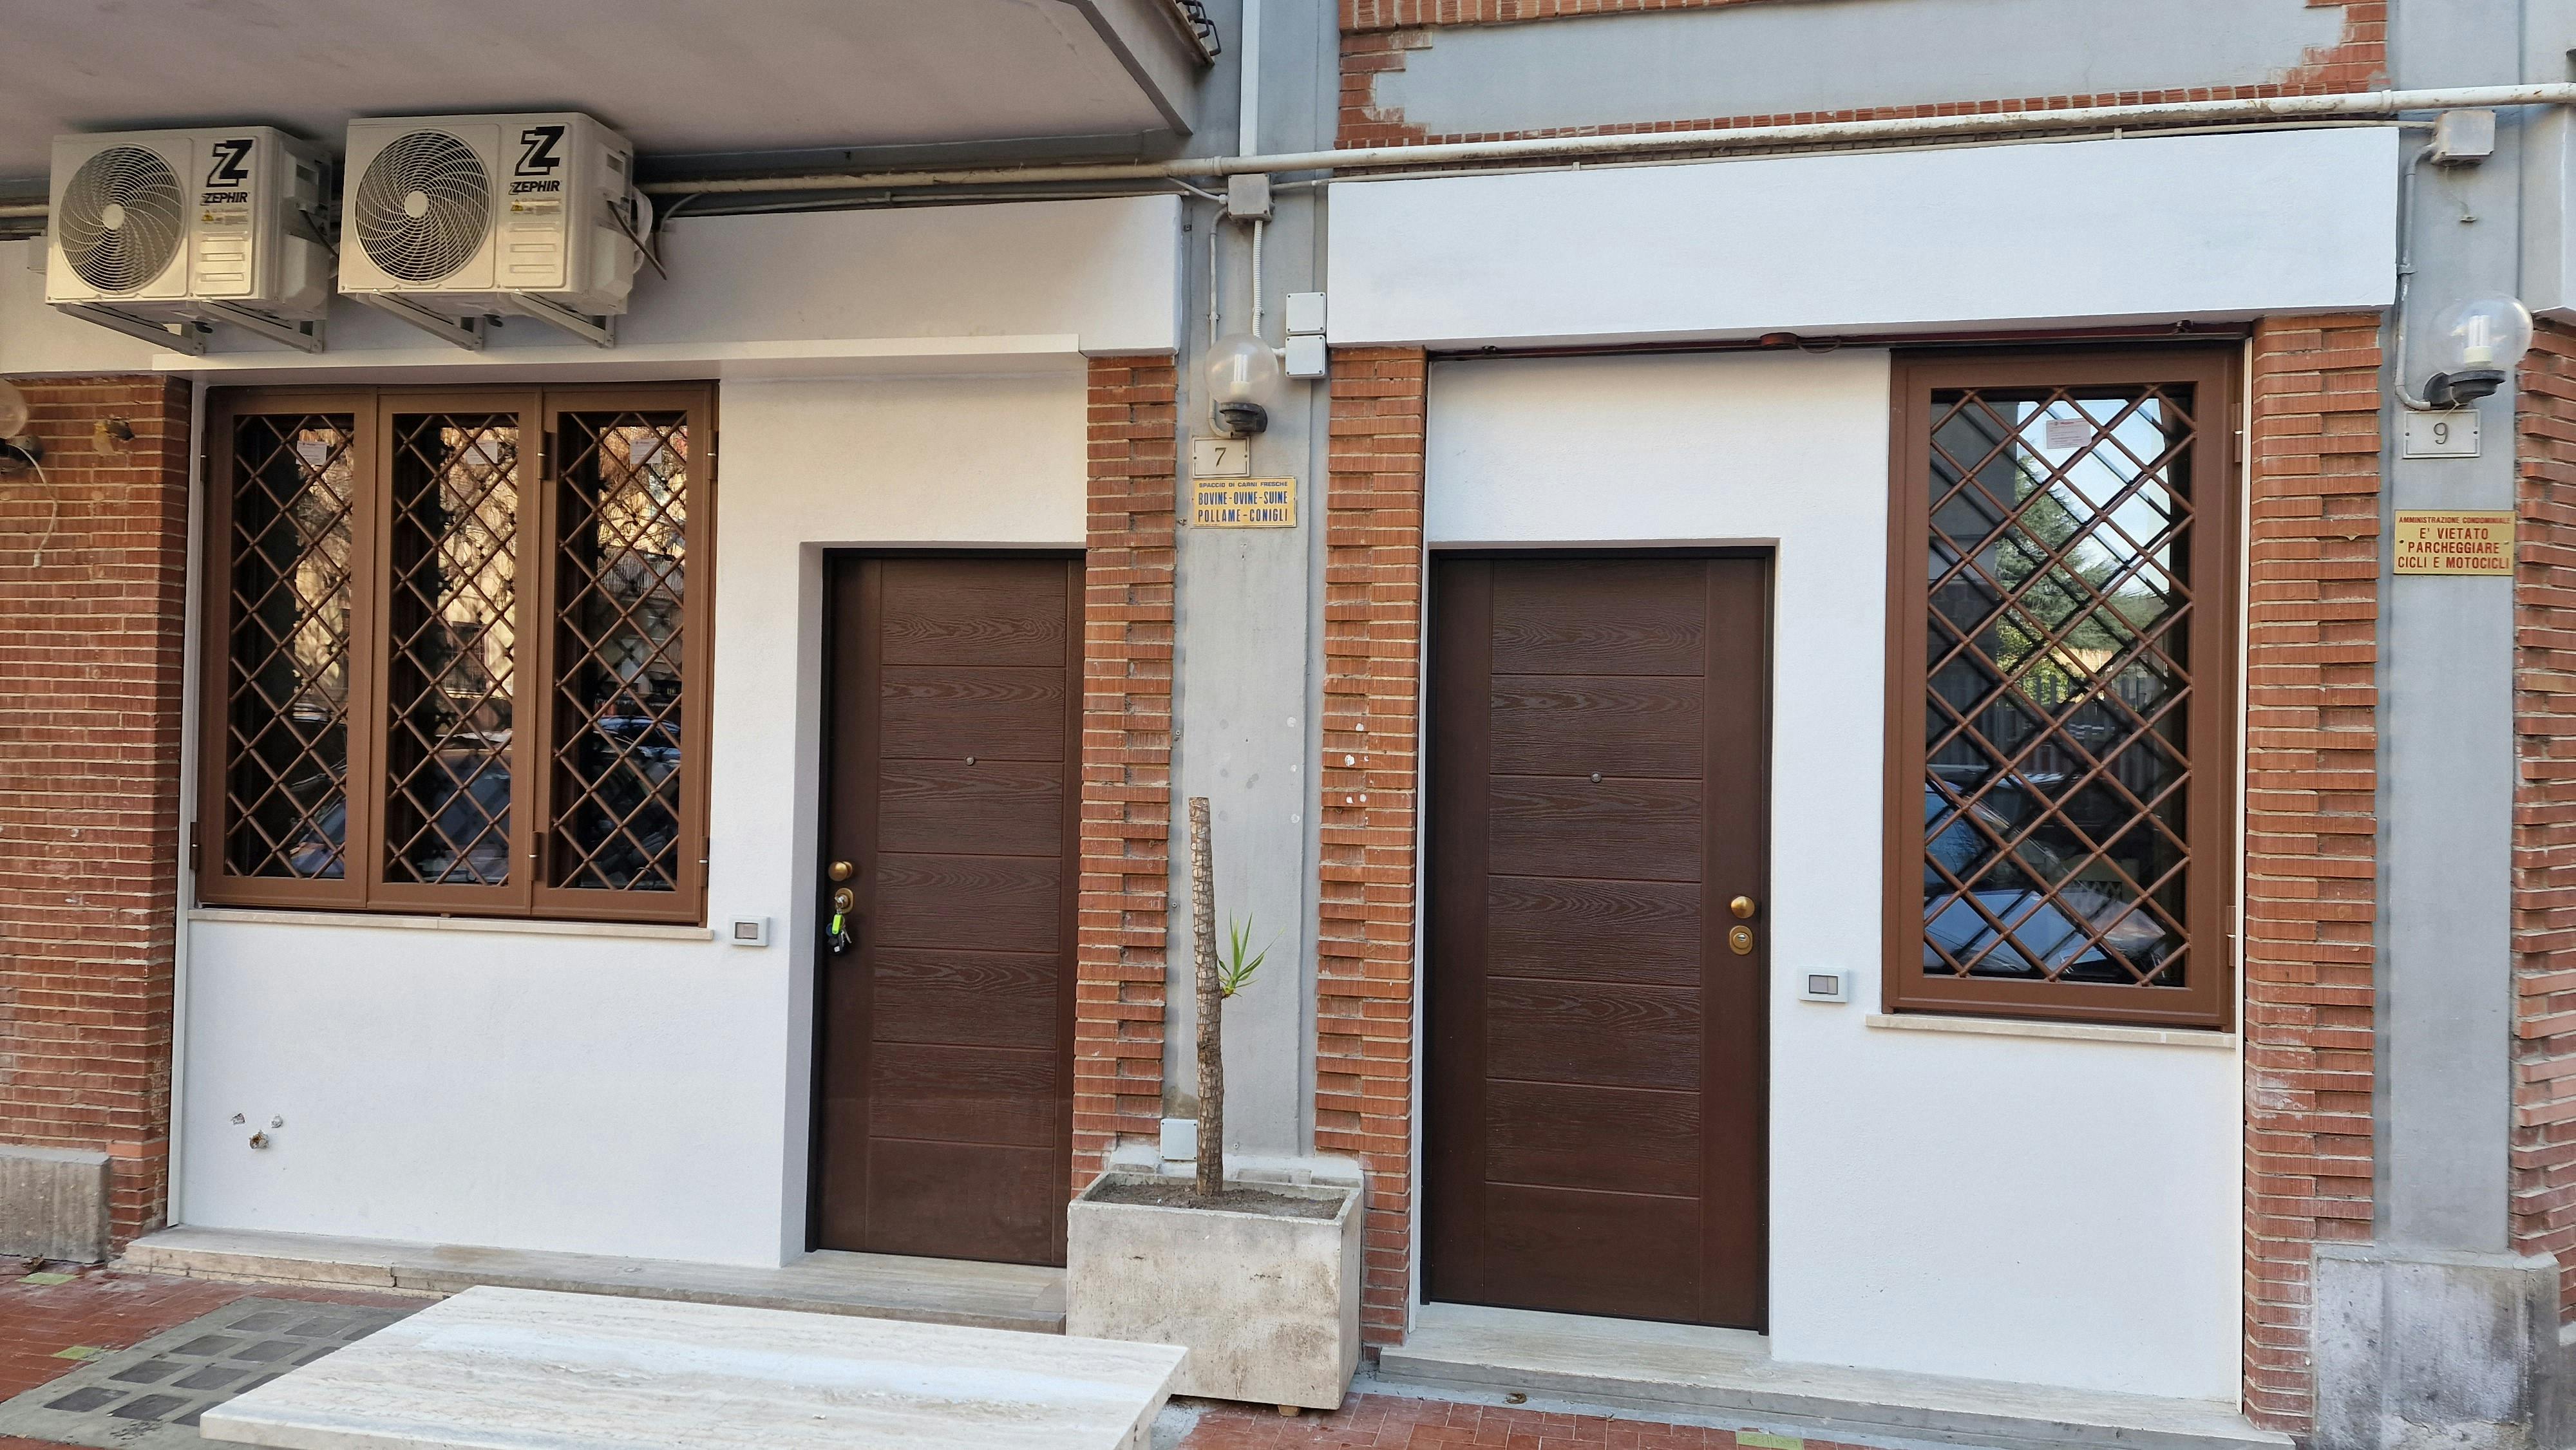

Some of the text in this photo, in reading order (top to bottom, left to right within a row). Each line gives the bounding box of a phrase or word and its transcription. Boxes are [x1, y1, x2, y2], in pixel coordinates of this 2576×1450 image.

[515, 126, 565, 176] Z
[206, 140, 253, 187] Z
[508, 180, 560, 195] ZEPHIR
[200, 192, 248, 205] ZEPHIR
[2434, 422, 2448, 444] 9
[1215, 447, 1226, 467] 7
[2420, 527, 2488, 540] E' VIETATO
[2408, 541, 2499, 554] PARCHEGGIARE
[2398, 556, 2509, 569] CICLI E MOTOCICLI
